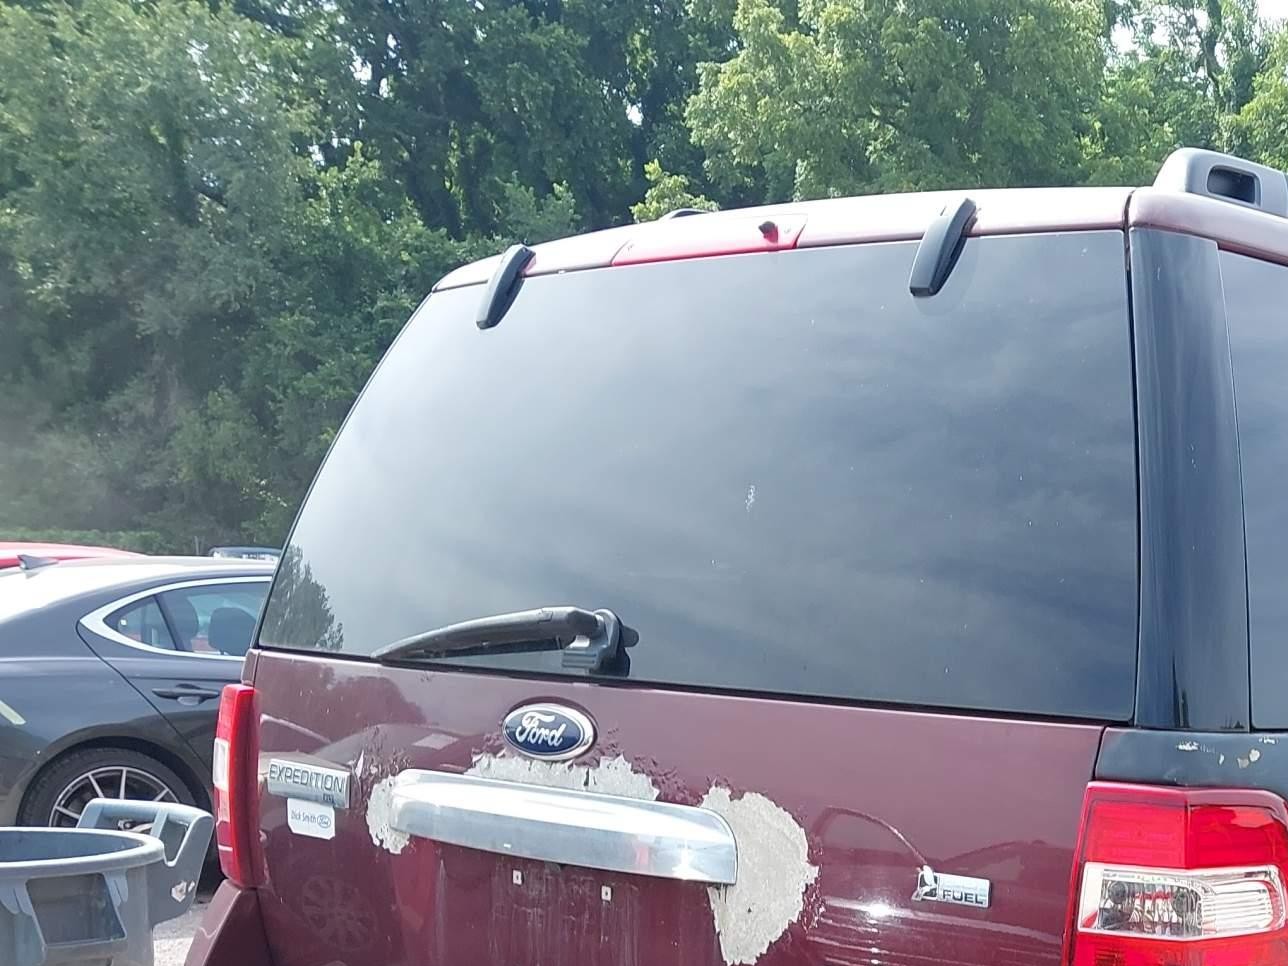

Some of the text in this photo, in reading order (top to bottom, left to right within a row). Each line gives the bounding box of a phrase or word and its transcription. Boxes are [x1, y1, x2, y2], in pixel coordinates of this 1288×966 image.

[515, 711, 567, 747] Ford
[269, 764, 344, 793] EXPEDITION
[943, 889, 984, 904] FUEL
